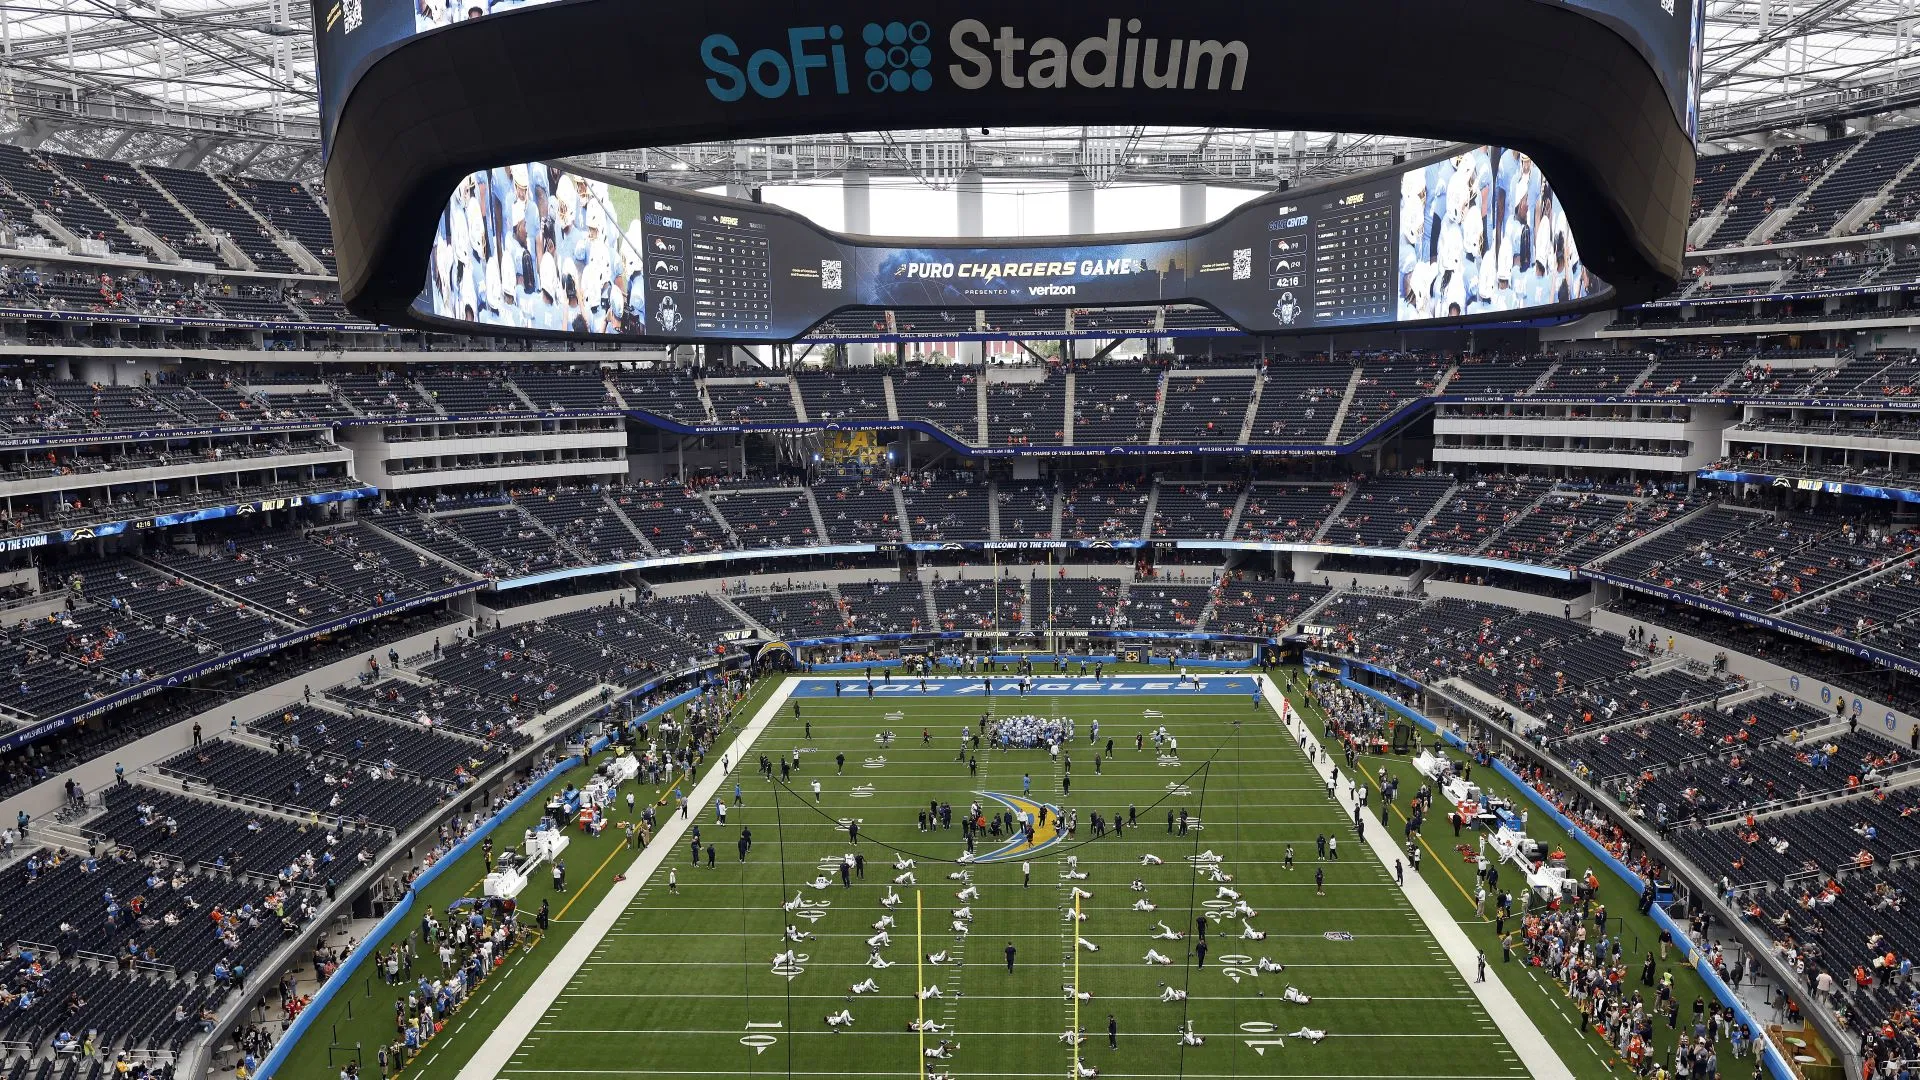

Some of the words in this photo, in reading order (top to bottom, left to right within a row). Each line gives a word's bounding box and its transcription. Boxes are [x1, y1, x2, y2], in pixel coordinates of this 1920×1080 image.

[700, 25, 850, 102] SoFi
[949, 18, 1249, 91] Stadium
[662, 217, 682, 229] CENTER
[1287, 216, 1308, 228] CENTER
[907, 263, 954, 278] PURO
[958, 261, 1076, 281] CHARGERS
[1080, 258, 1131, 276] GAME
[657, 280, 678, 290] 42:16
[1277, 277, 1299, 287] 42:16
[1029, 284, 1076, 296] verizon
[835, 431, 870, 452] LA
[1797, 480, 1811, 490] BOLT
[1812, 481, 1822, 491] UP
[1828, 483, 1842, 493] LA
[261, 501, 275, 511] BOLT
[276, 500, 285, 509] UP
[135, 521, 151, 529] 42:16
[7, 540, 21, 550] THE
[22, 536, 47, 547] STORM
[358, 615, 372, 624] CALL
[741, 630, 752, 639] UP
[1303, 625, 1321, 635] BOLT
[1322, 627, 1336, 636] UP
[1126, 652, 1138, 662] 25
[1874, 657, 1891, 668] CALL
[183, 672, 199, 683] CALL
[841, 683, 945, 693] LOS
[953, 682, 1208, 695] ANGELES
[72, 713, 85, 725] TAKE
[86, 705, 106, 719] CHARGE
[106, 702, 114, 712] OF
[45, 723, 53, 734] LAW
[53, 719, 65, 730] FIRM
[1202, 900, 1236, 919] 30
[1219, 954, 1259, 977] 20
[740, 1020, 783, 1047] 10
[1240, 1021, 1285, 1048] 10
